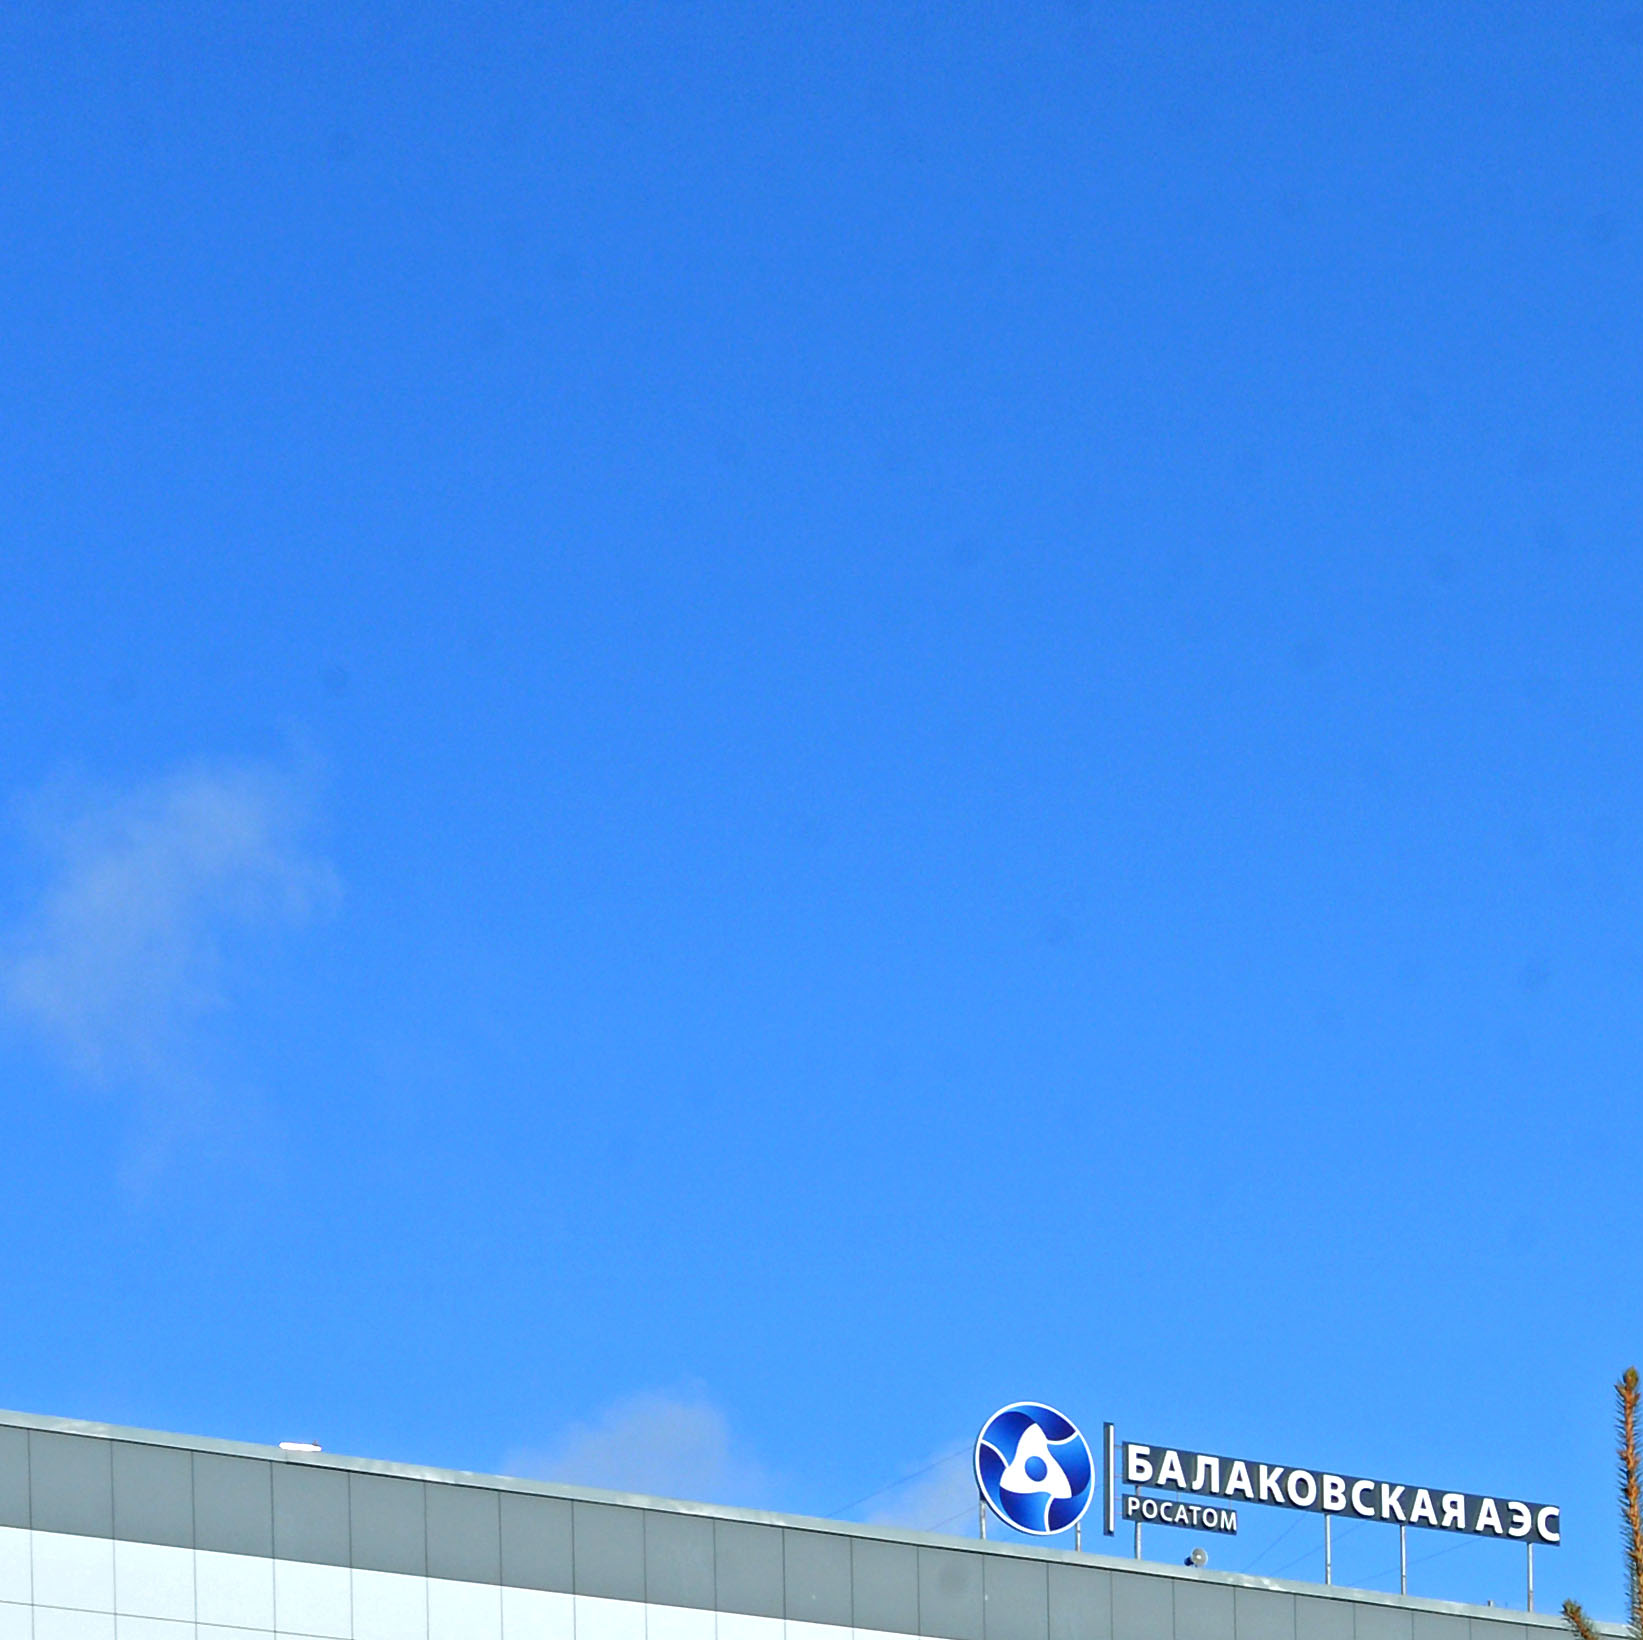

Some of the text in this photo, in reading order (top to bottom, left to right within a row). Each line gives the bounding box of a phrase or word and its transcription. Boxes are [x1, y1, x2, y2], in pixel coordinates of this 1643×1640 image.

[1127, 1443, 1561, 1543] БАЛАКОВСКАЯ АЭС
[1127, 1496, 1238, 1532] РОСАТОМ
